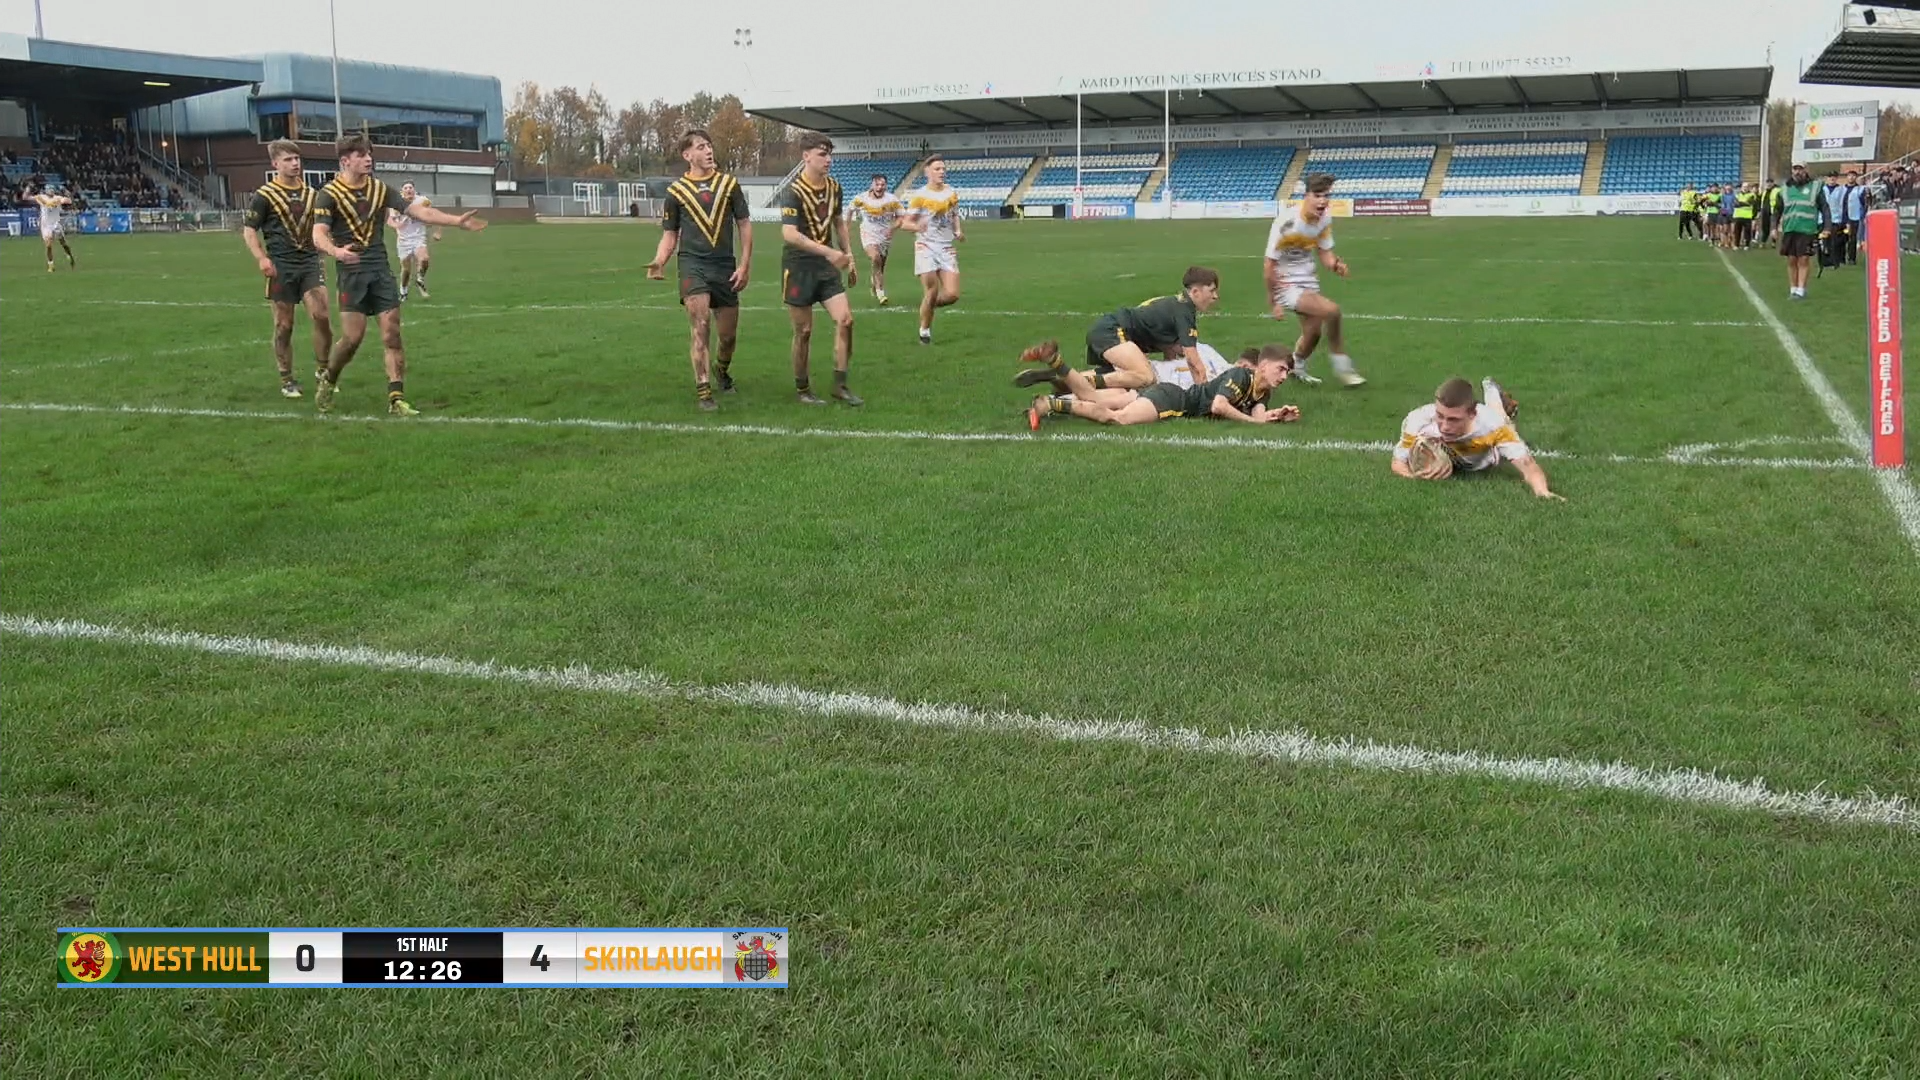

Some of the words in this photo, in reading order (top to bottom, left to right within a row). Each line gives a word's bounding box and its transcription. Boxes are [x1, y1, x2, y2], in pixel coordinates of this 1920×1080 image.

[1080, 77, 1119, 90] WARD
[1193, 70, 1265, 84] SERVICES
[1269, 68, 1322, 80] STAND
[1822, 106, 1863, 116] bartercard
[1876, 258, 1892, 343] BETFRED
[1879, 352, 1895, 436] BETFRED
